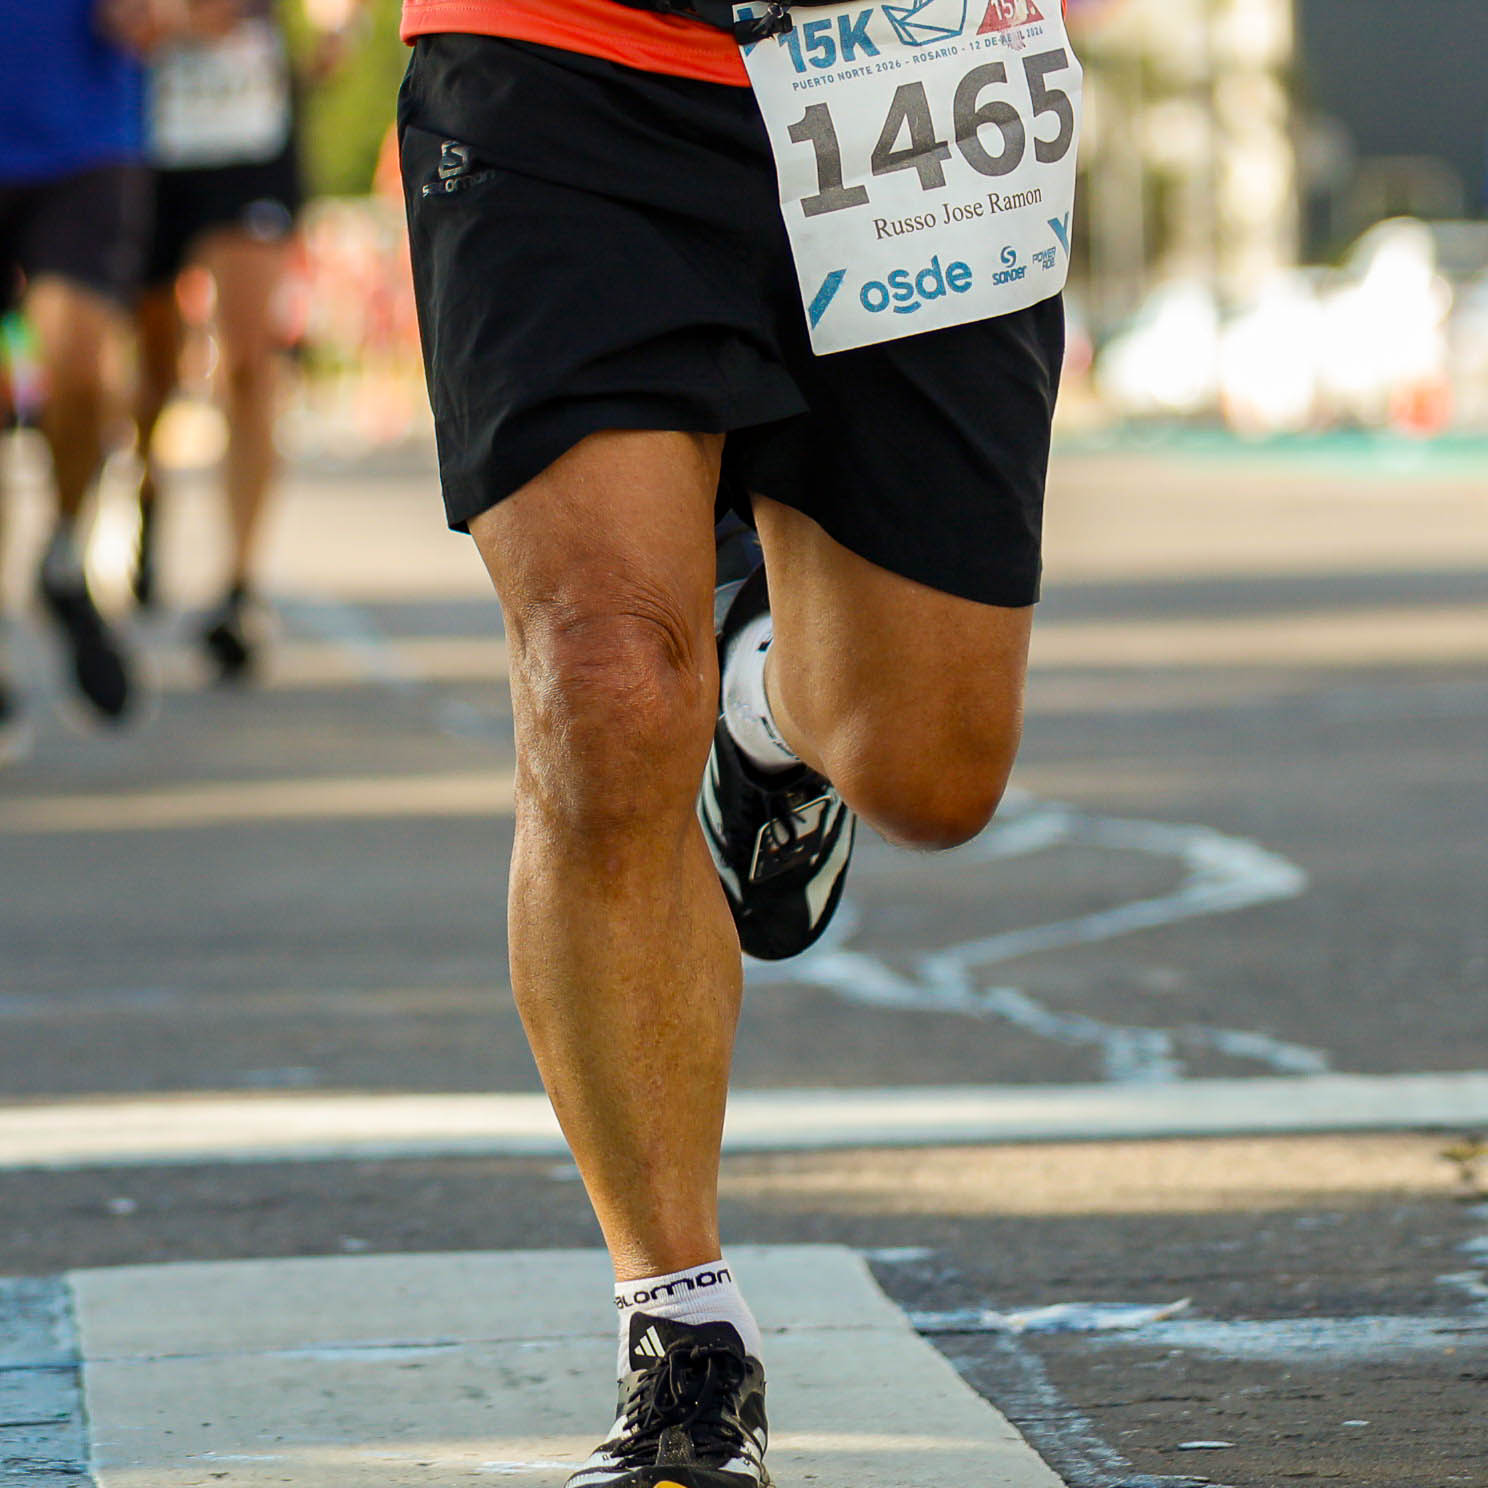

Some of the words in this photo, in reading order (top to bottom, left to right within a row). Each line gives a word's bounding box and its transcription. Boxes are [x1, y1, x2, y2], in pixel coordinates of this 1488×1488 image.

[777, 8, 881, 73] 15K
[792, 74, 835, 91] PUERTO
[837, 65, 873, 81] NORTE
[875, 60, 902, 73] 2026
[912, 46, 958, 64] ROSARIO
[969, 40, 981, 51] 12
[985, 36, 998, 48] DE
[787, 48, 1074, 217] 1465
[873, 212, 937, 240] Russo
[942, 201, 984, 225] Jose
[987, 187, 1043, 214] Ramon
[859, 254, 973, 313] osde
